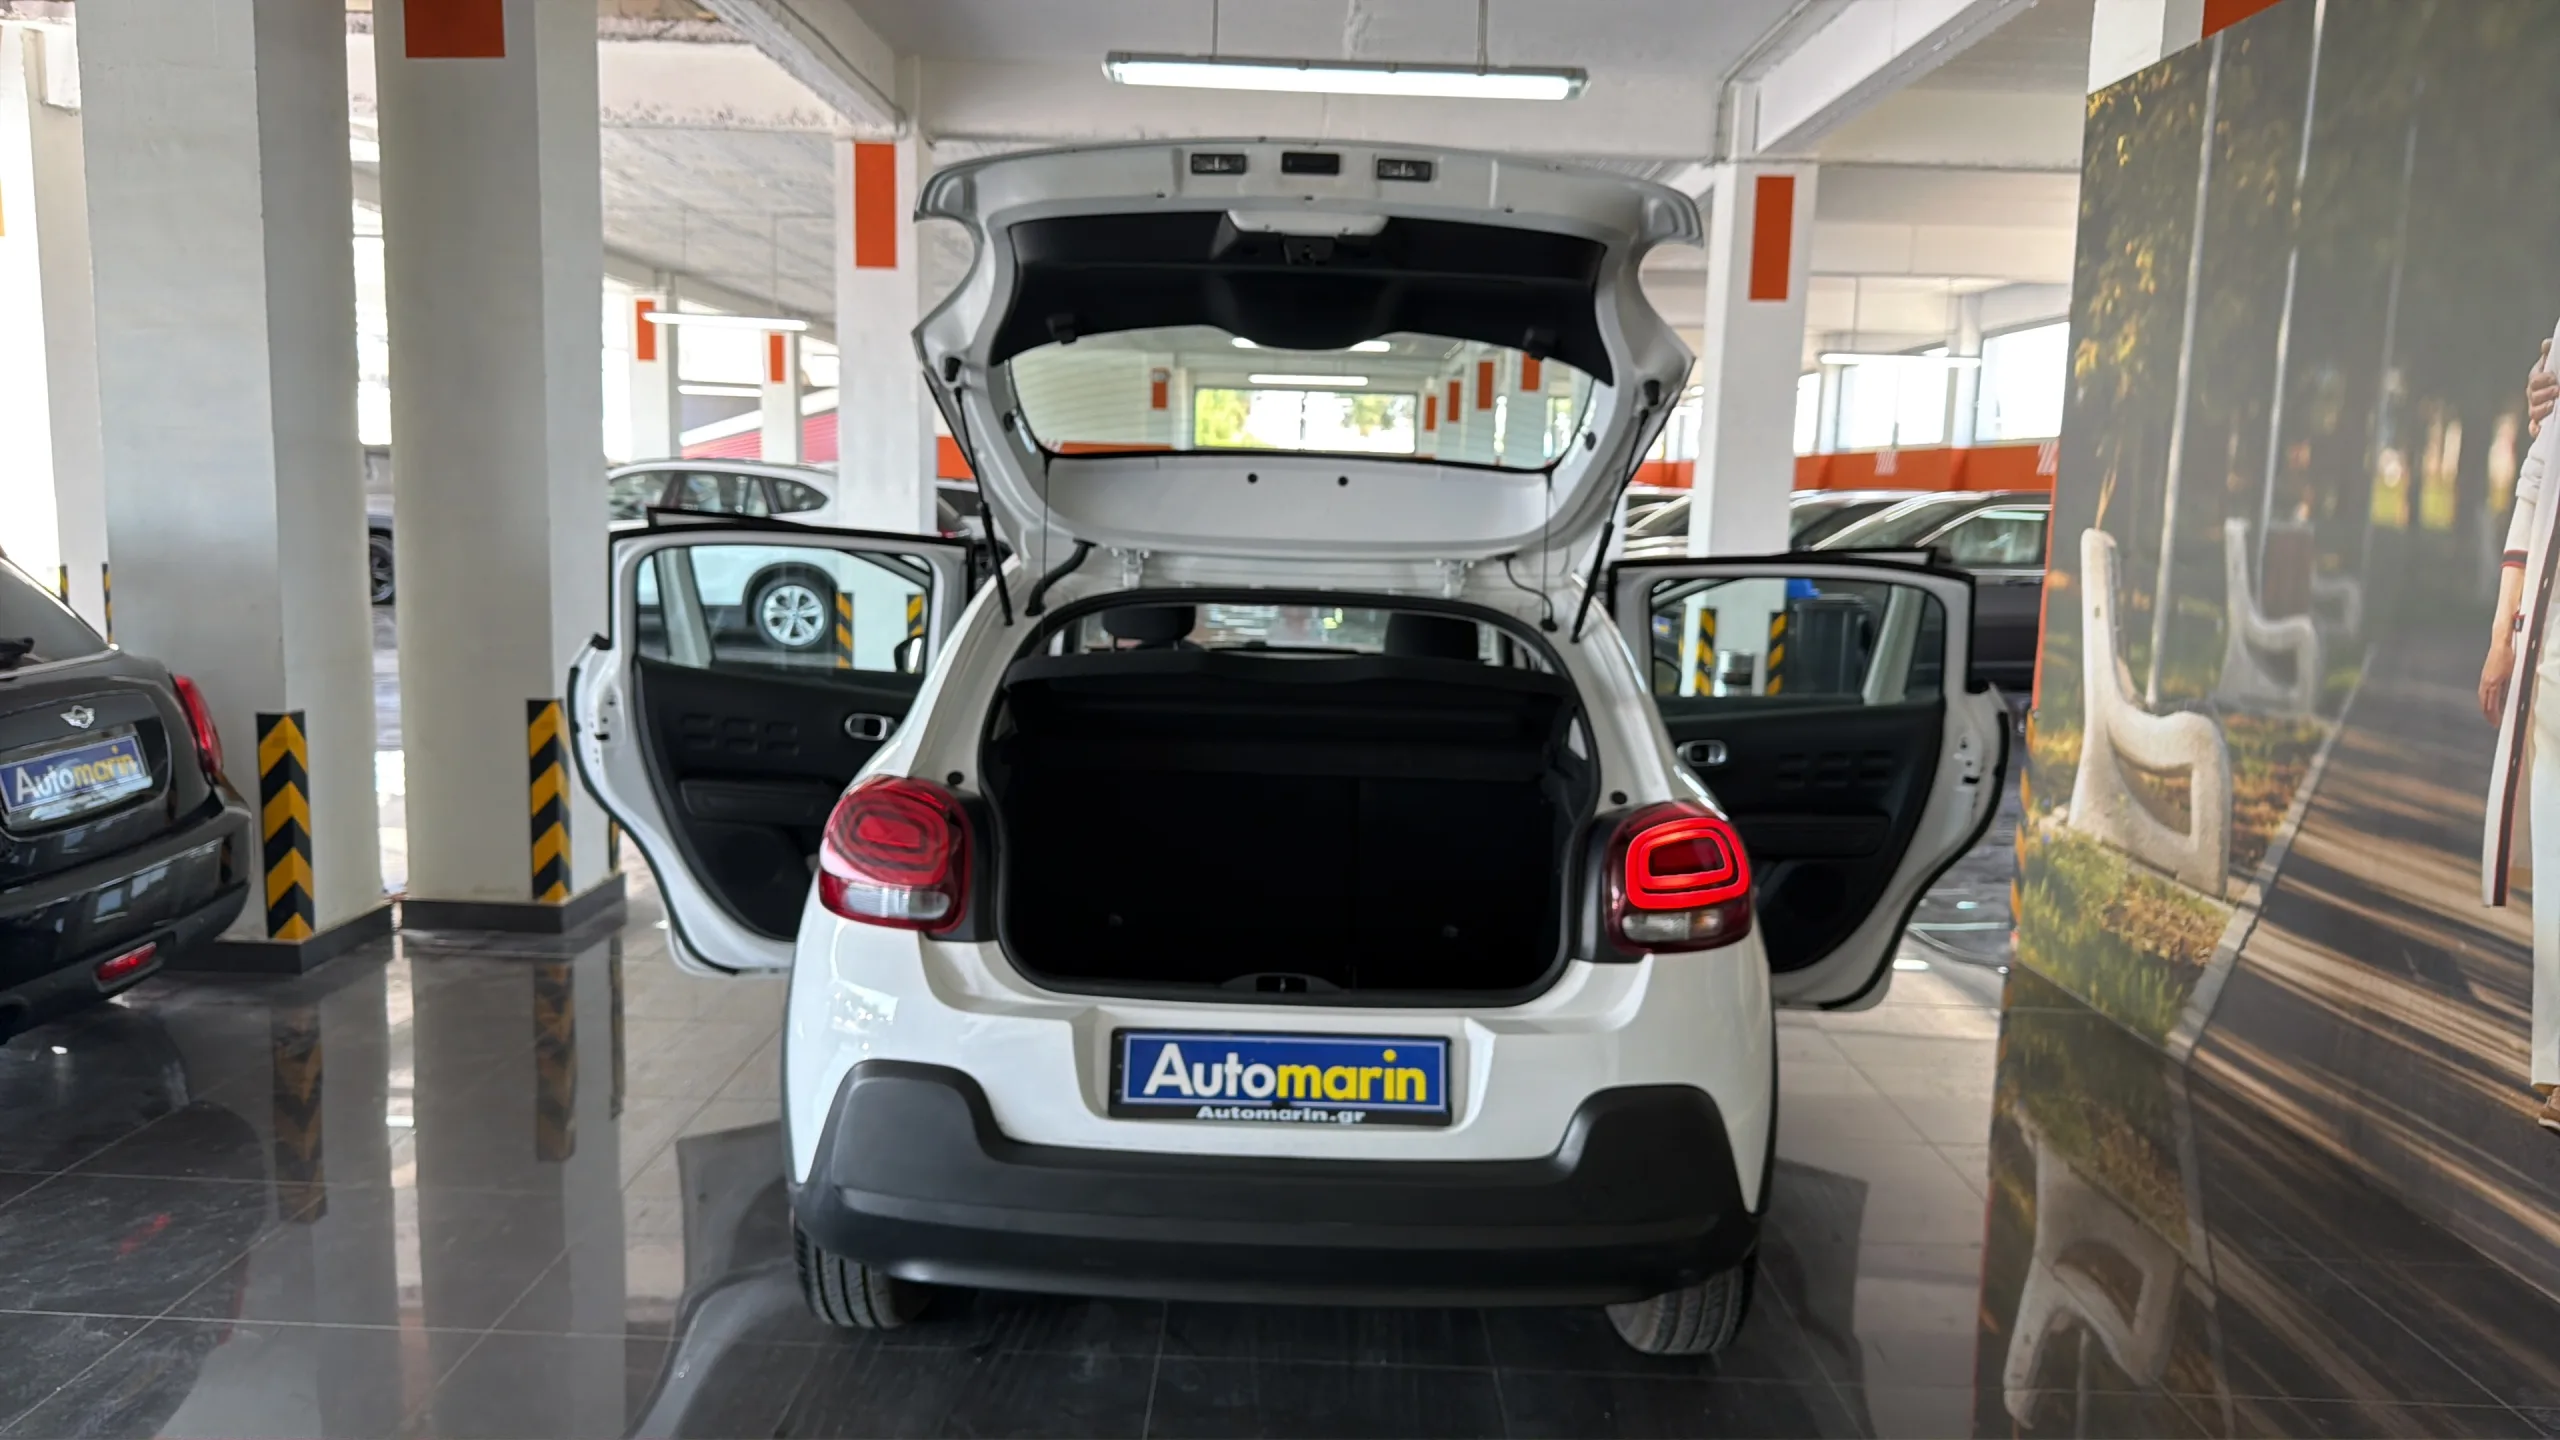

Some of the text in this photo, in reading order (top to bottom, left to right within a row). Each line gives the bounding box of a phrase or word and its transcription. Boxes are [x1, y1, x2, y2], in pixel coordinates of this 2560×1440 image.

[15, 745, 138, 803] Automarin
[1143, 1043, 1427, 1101] Automarin
[1196, 1105, 1366, 1124] Automarin.gr
